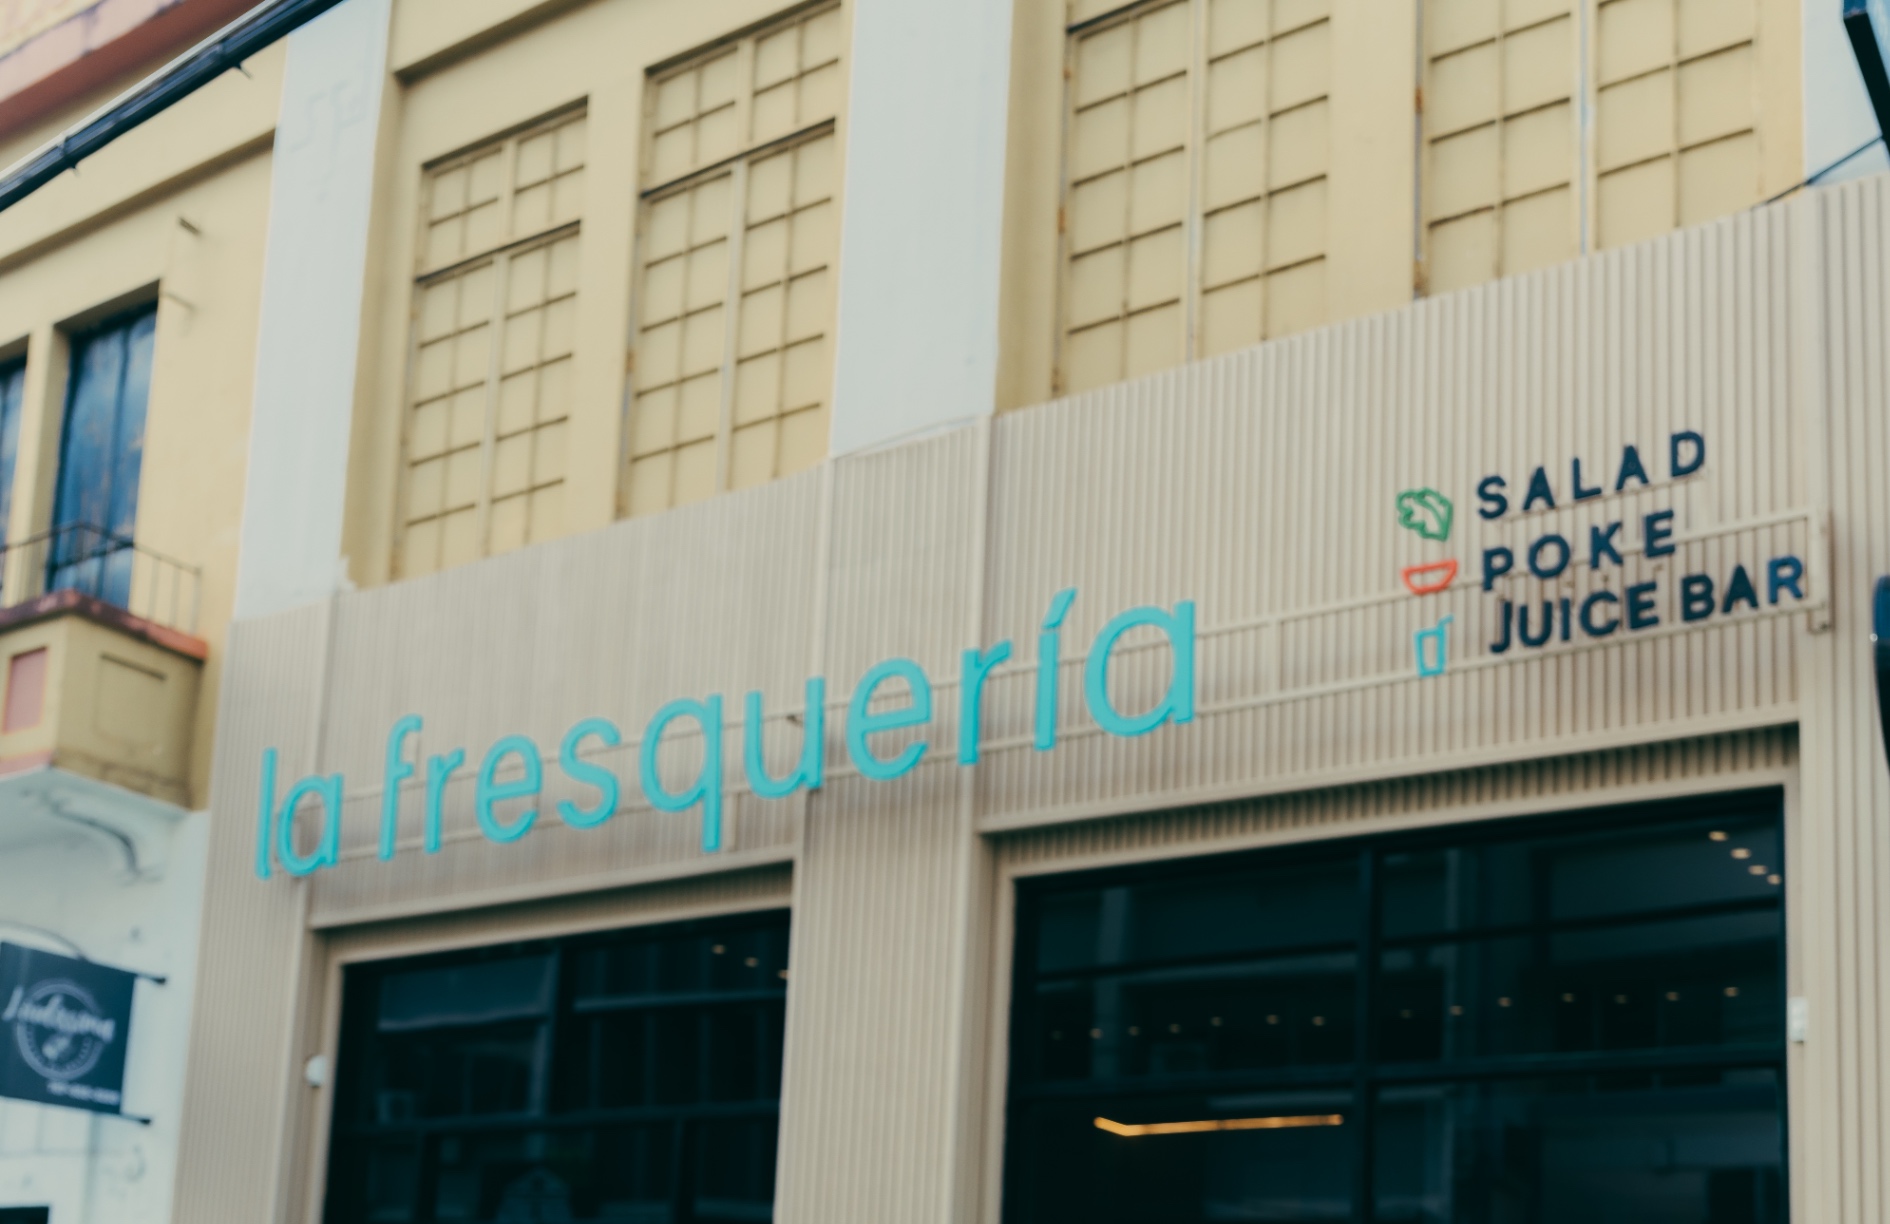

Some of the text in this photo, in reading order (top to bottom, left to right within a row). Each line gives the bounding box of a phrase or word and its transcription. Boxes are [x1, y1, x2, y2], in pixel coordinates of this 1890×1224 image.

[1476, 430, 1706, 520] SALAD
[1482, 508, 1676, 592] POKE
[1490, 555, 1805, 654] JUICE BAR
[255, 588, 1197, 881] la fresquería
